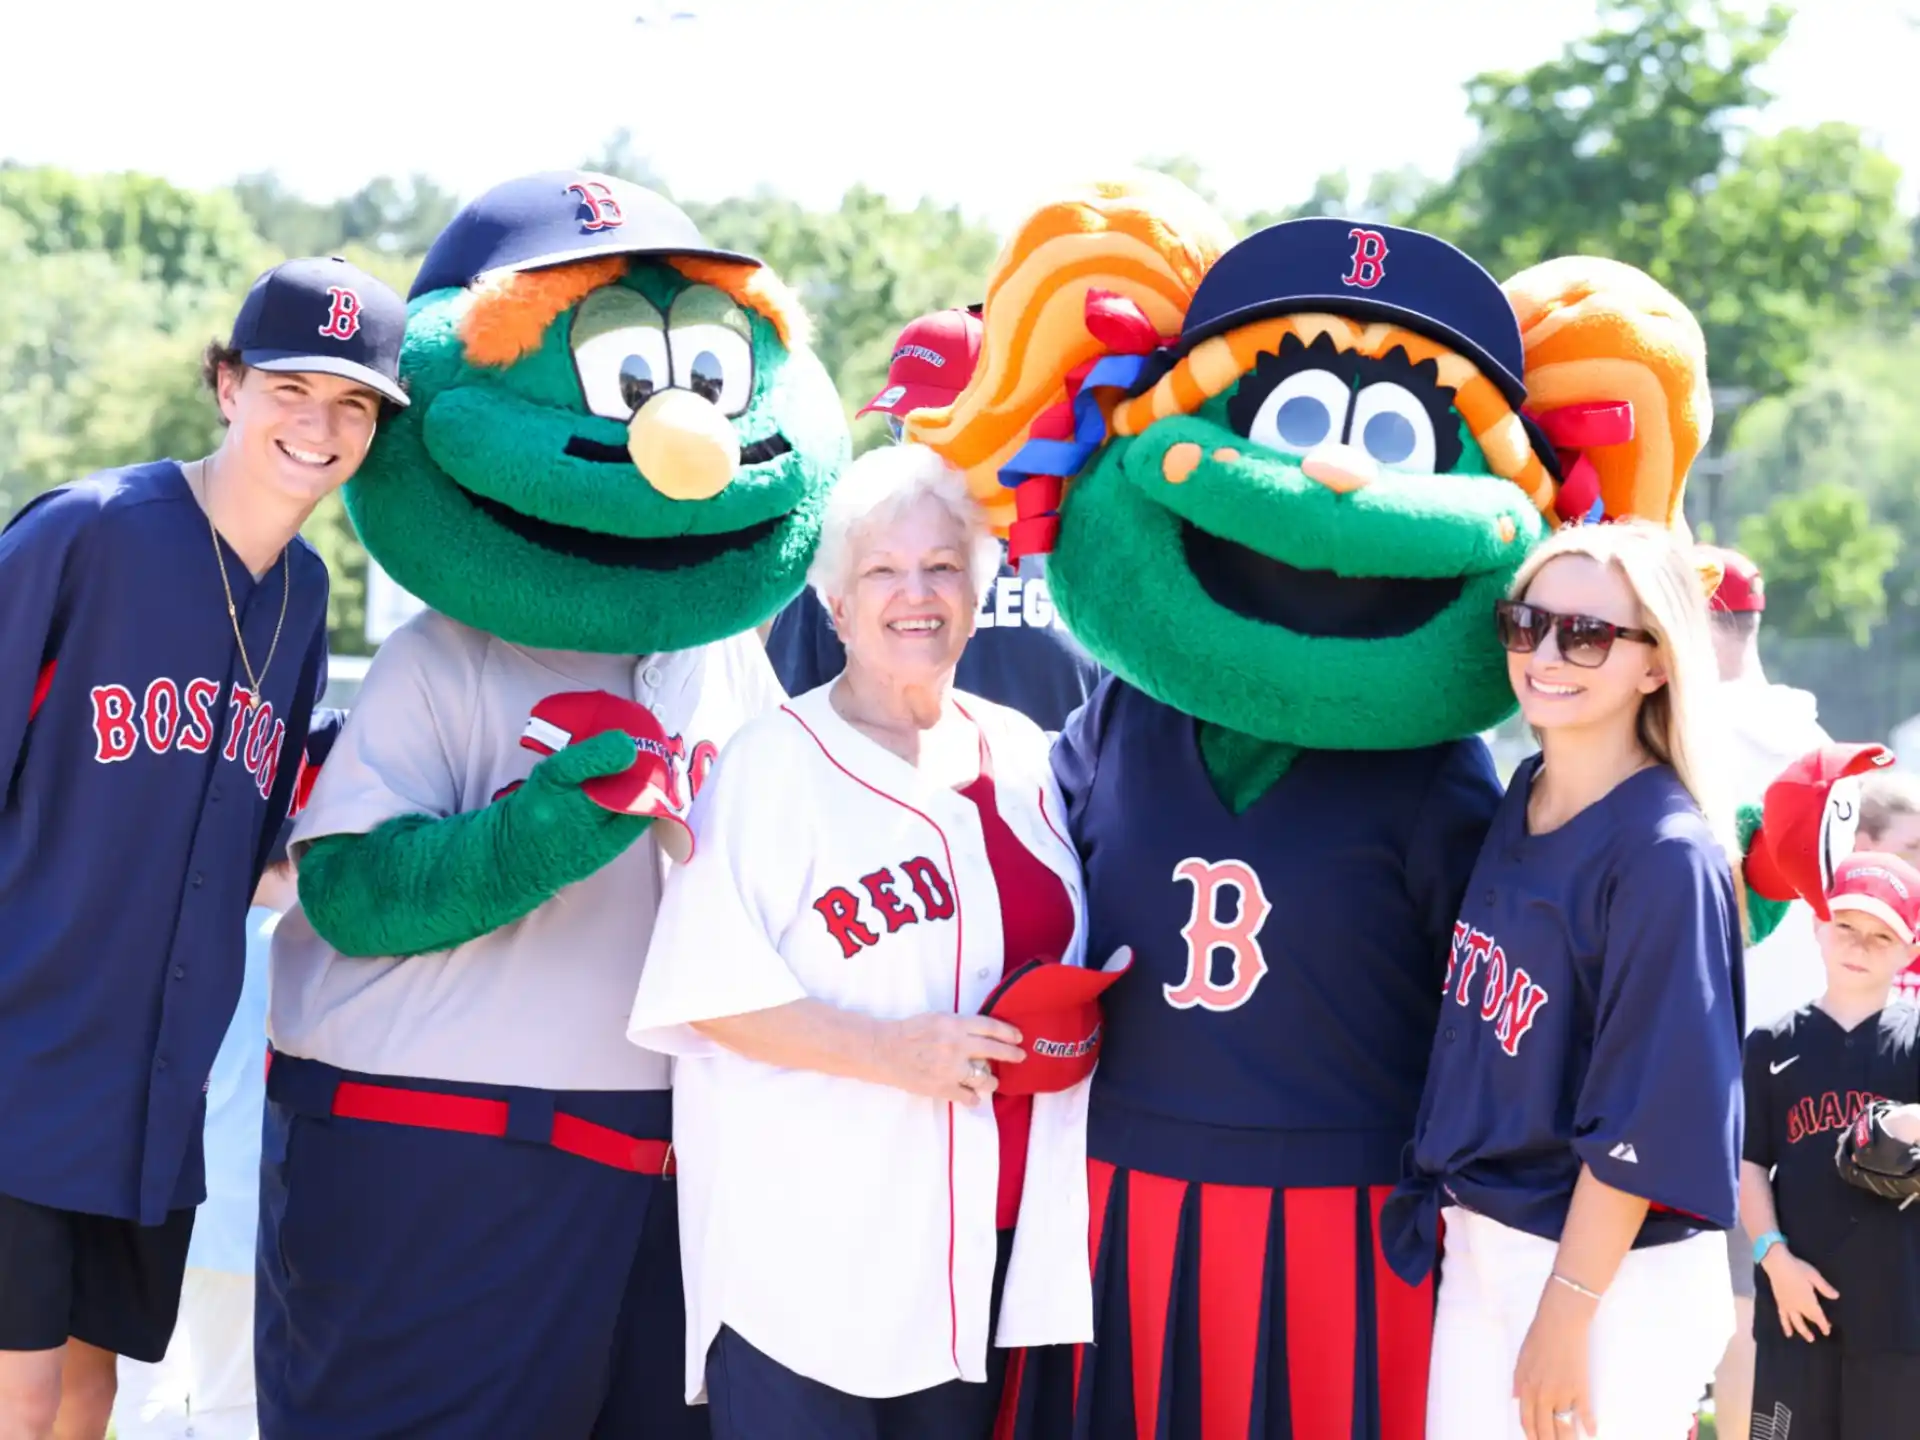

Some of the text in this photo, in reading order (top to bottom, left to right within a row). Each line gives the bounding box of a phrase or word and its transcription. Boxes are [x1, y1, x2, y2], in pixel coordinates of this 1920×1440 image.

[1341, 228, 1389, 289] B
[318, 285, 363, 340] B
[91, 677, 285, 800] BOSTON
[813, 856, 954, 959] RED
[1163, 857, 1272, 1012] B
[1033, 1038, 1076, 1058] FUND
[1787, 1090, 1885, 1143] GIAN
